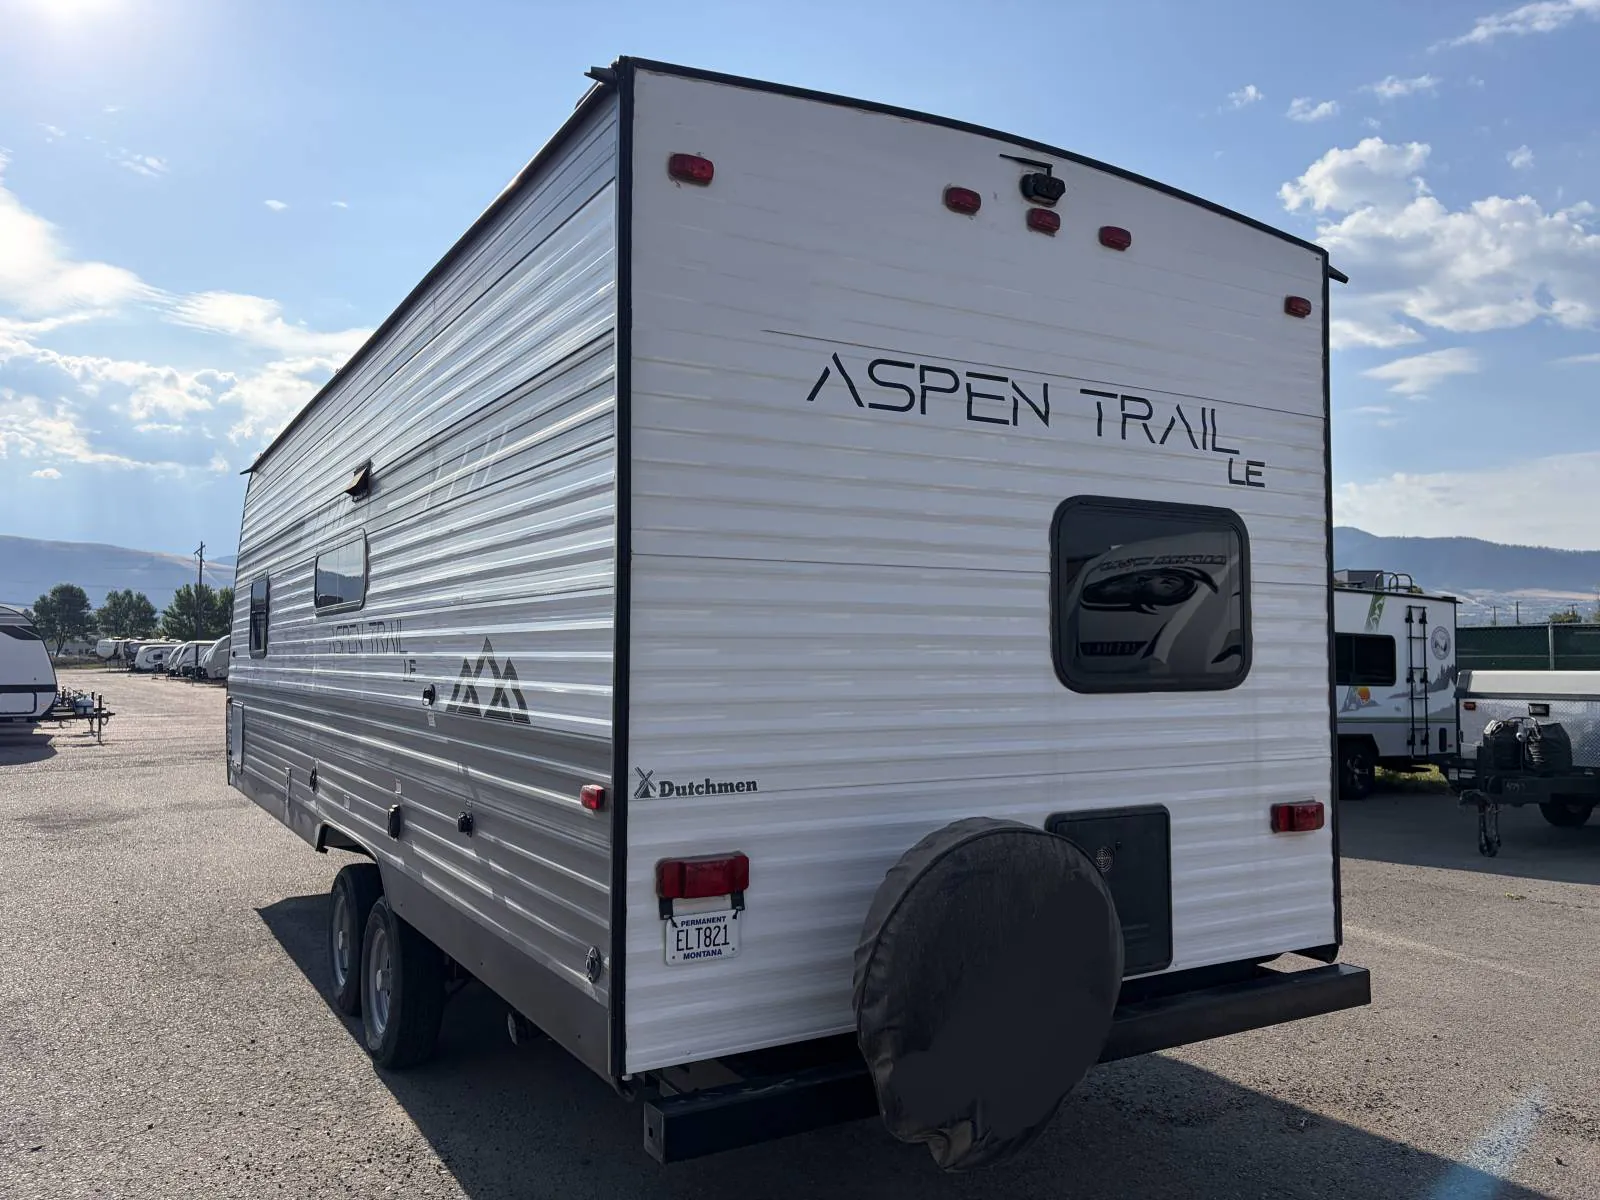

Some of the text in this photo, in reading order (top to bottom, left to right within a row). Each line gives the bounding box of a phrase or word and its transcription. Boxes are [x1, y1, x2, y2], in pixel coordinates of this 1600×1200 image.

[806, 352, 1241, 455] ASPEN TRAIL
[1228, 457, 1266, 488] LE
[368, 618, 408, 655] TRAIL
[402, 658, 417, 682] LE
[658, 778, 758, 798] Dutchmen
[680, 915, 727, 927] PERMANENT
[676, 924, 730, 952] ELT821
[683, 948, 723, 960] MONTANA
